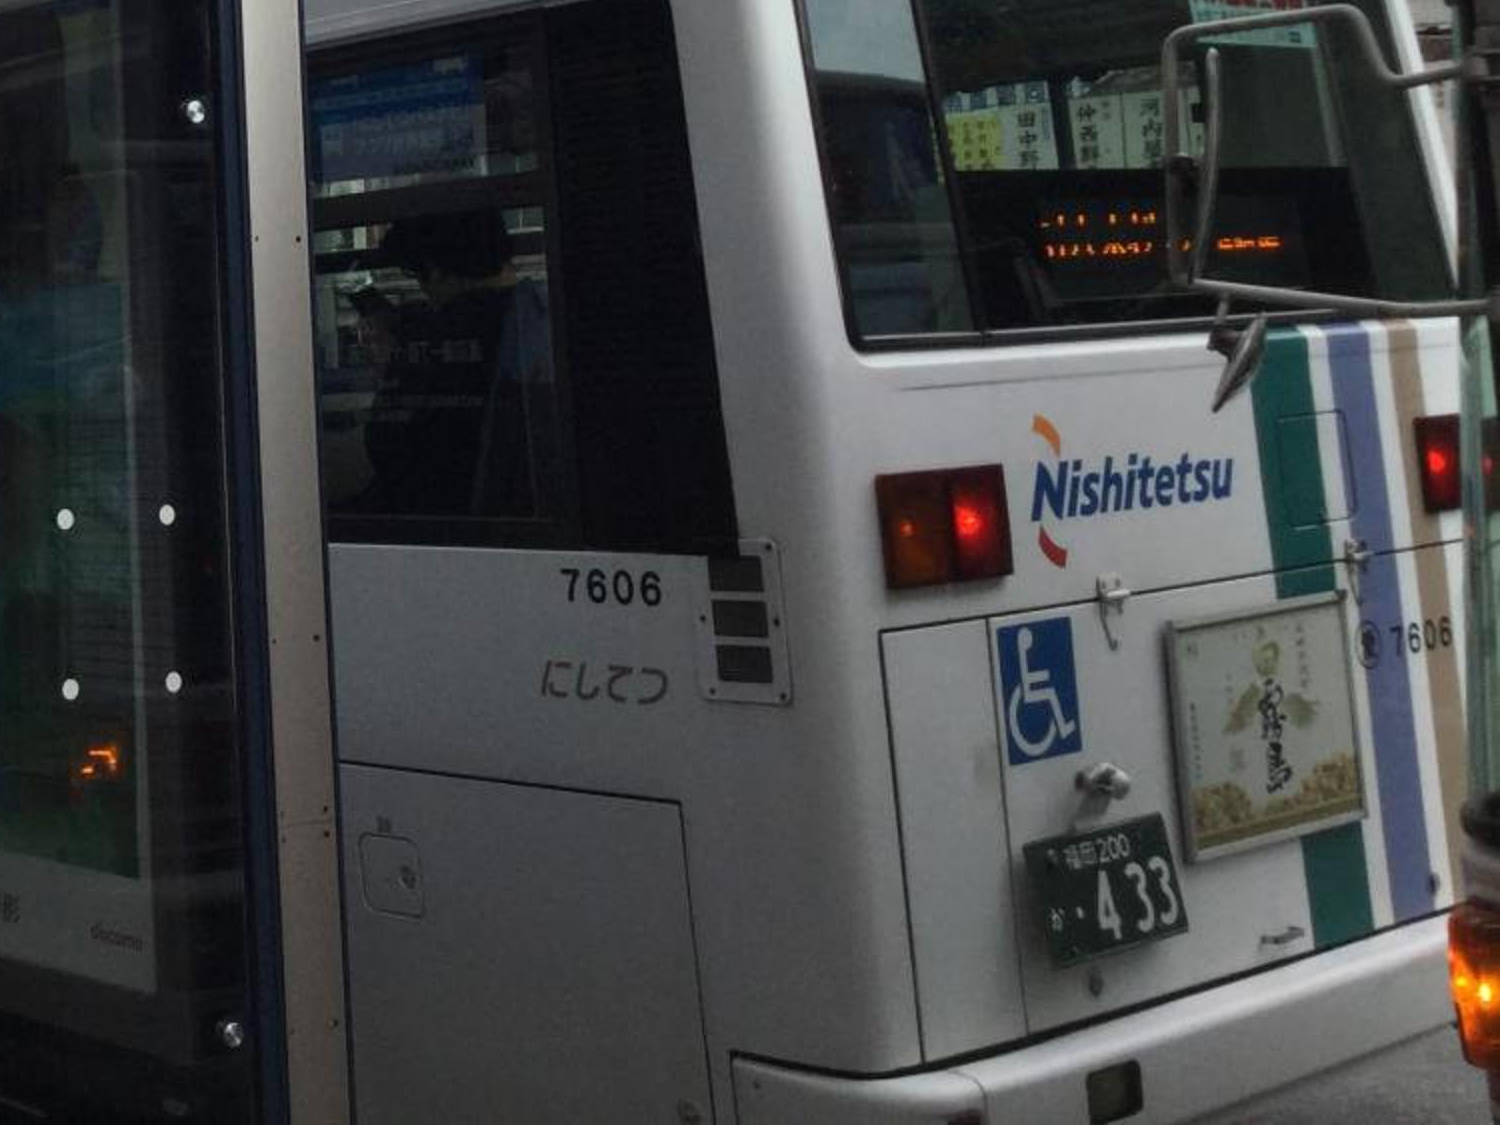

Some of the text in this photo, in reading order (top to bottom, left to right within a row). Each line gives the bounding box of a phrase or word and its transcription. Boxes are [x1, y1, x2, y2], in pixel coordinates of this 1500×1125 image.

[1031, 451, 1235, 522] Nishitetsu
[560, 568, 662, 606] 7606
[1388, 616, 1453, 657] 7606
[541, 660, 669, 705] にしてつ
[1097, 856, 1179, 940] 433
